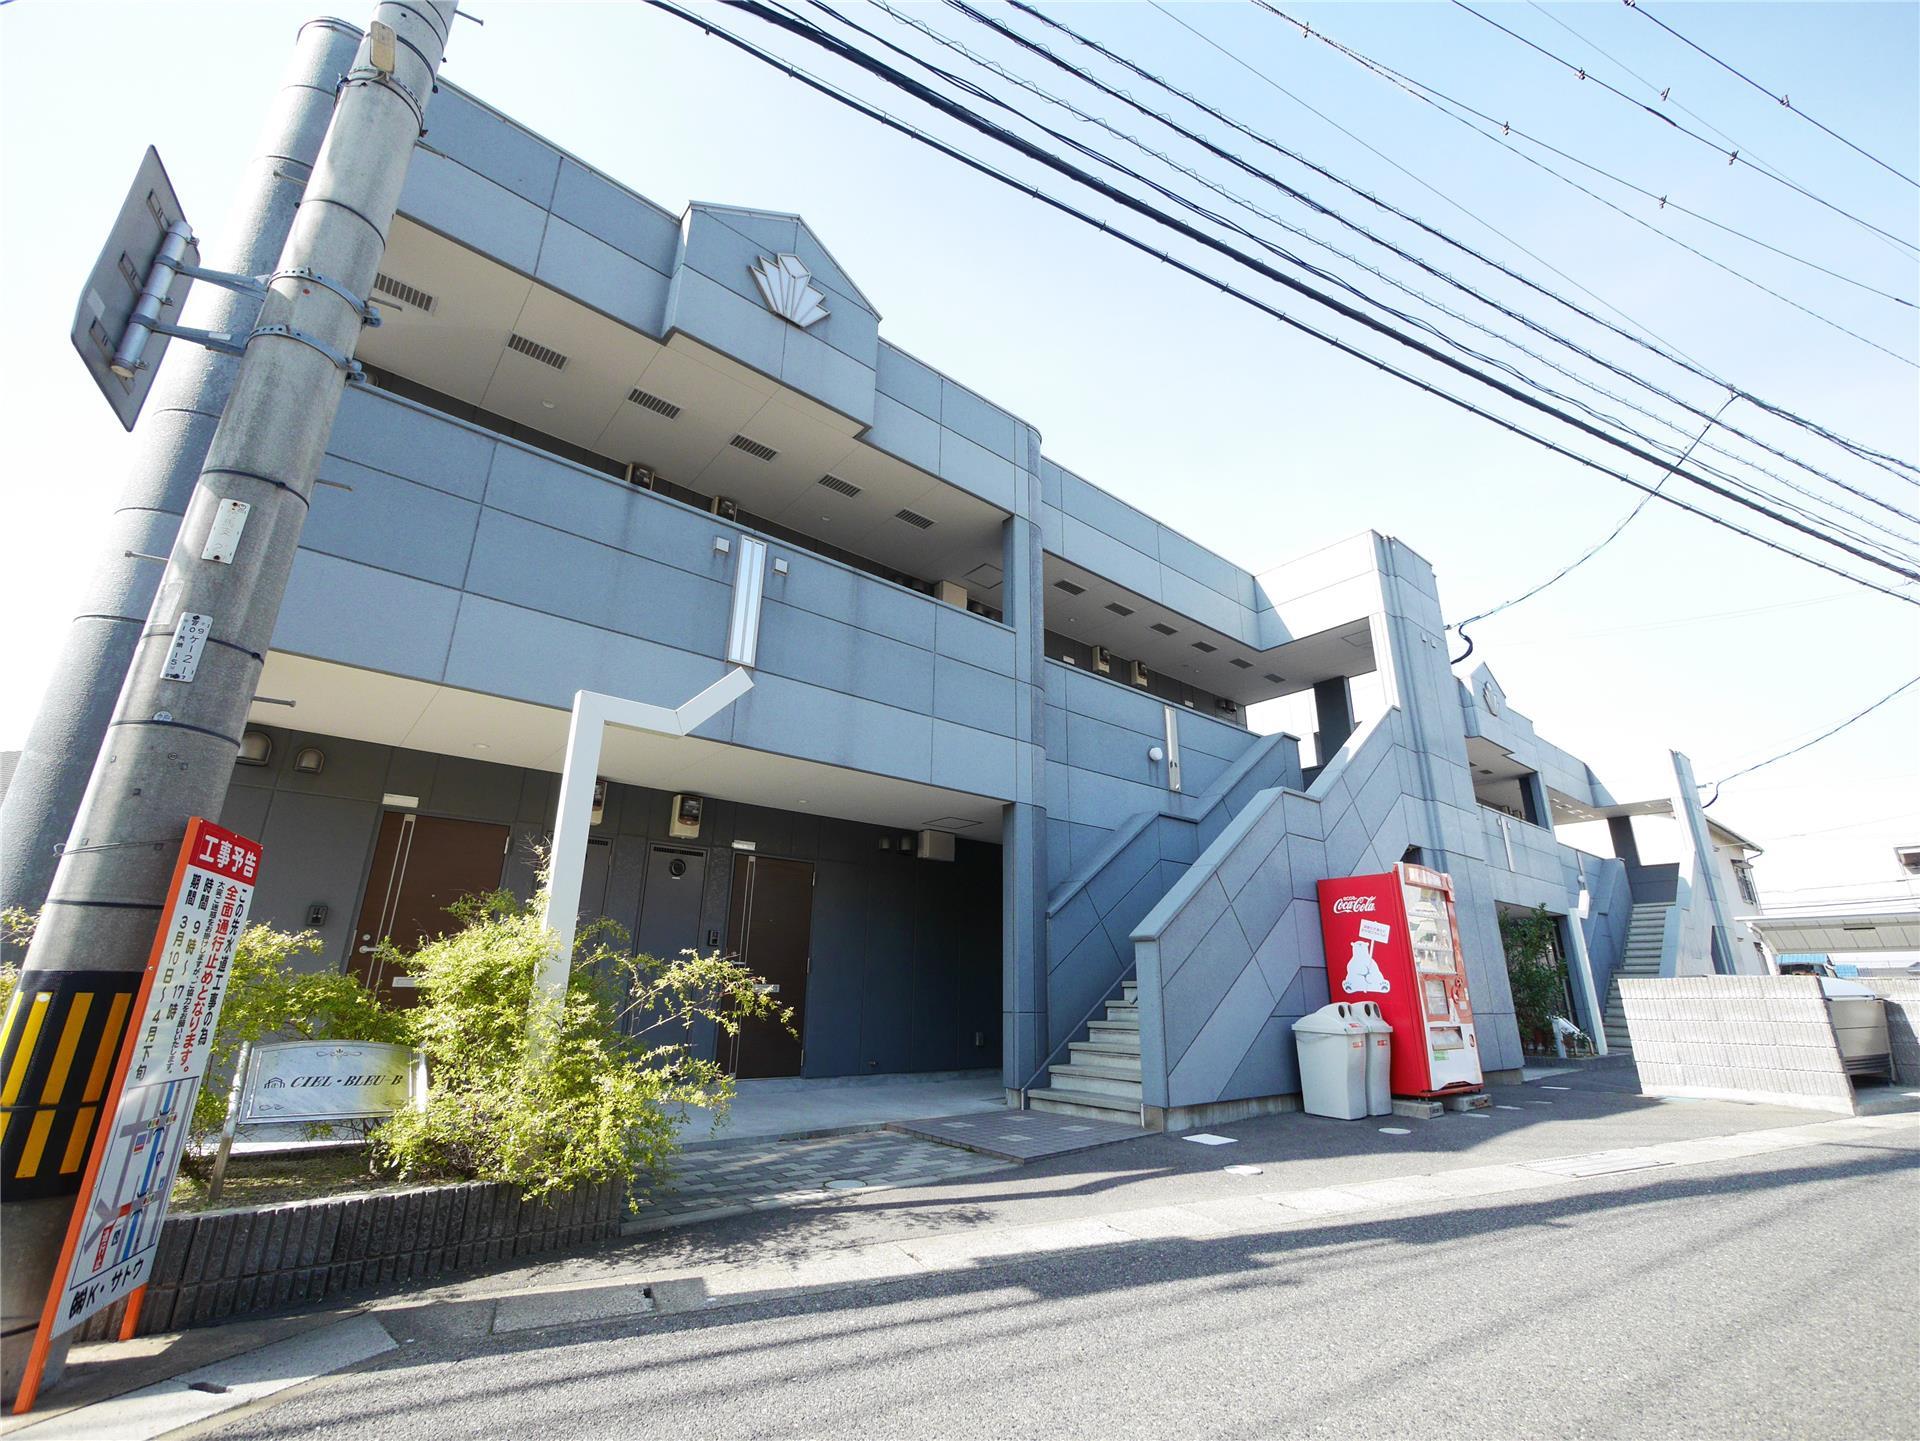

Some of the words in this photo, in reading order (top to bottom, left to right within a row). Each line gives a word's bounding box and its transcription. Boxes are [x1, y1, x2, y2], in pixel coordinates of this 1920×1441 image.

[199, 834, 257, 878] 工事予告
[185, 873, 201, 906] 期間
[198, 878, 214, 911] 時間
[180, 885, 239, 1073] 全面通行止めとなります。
